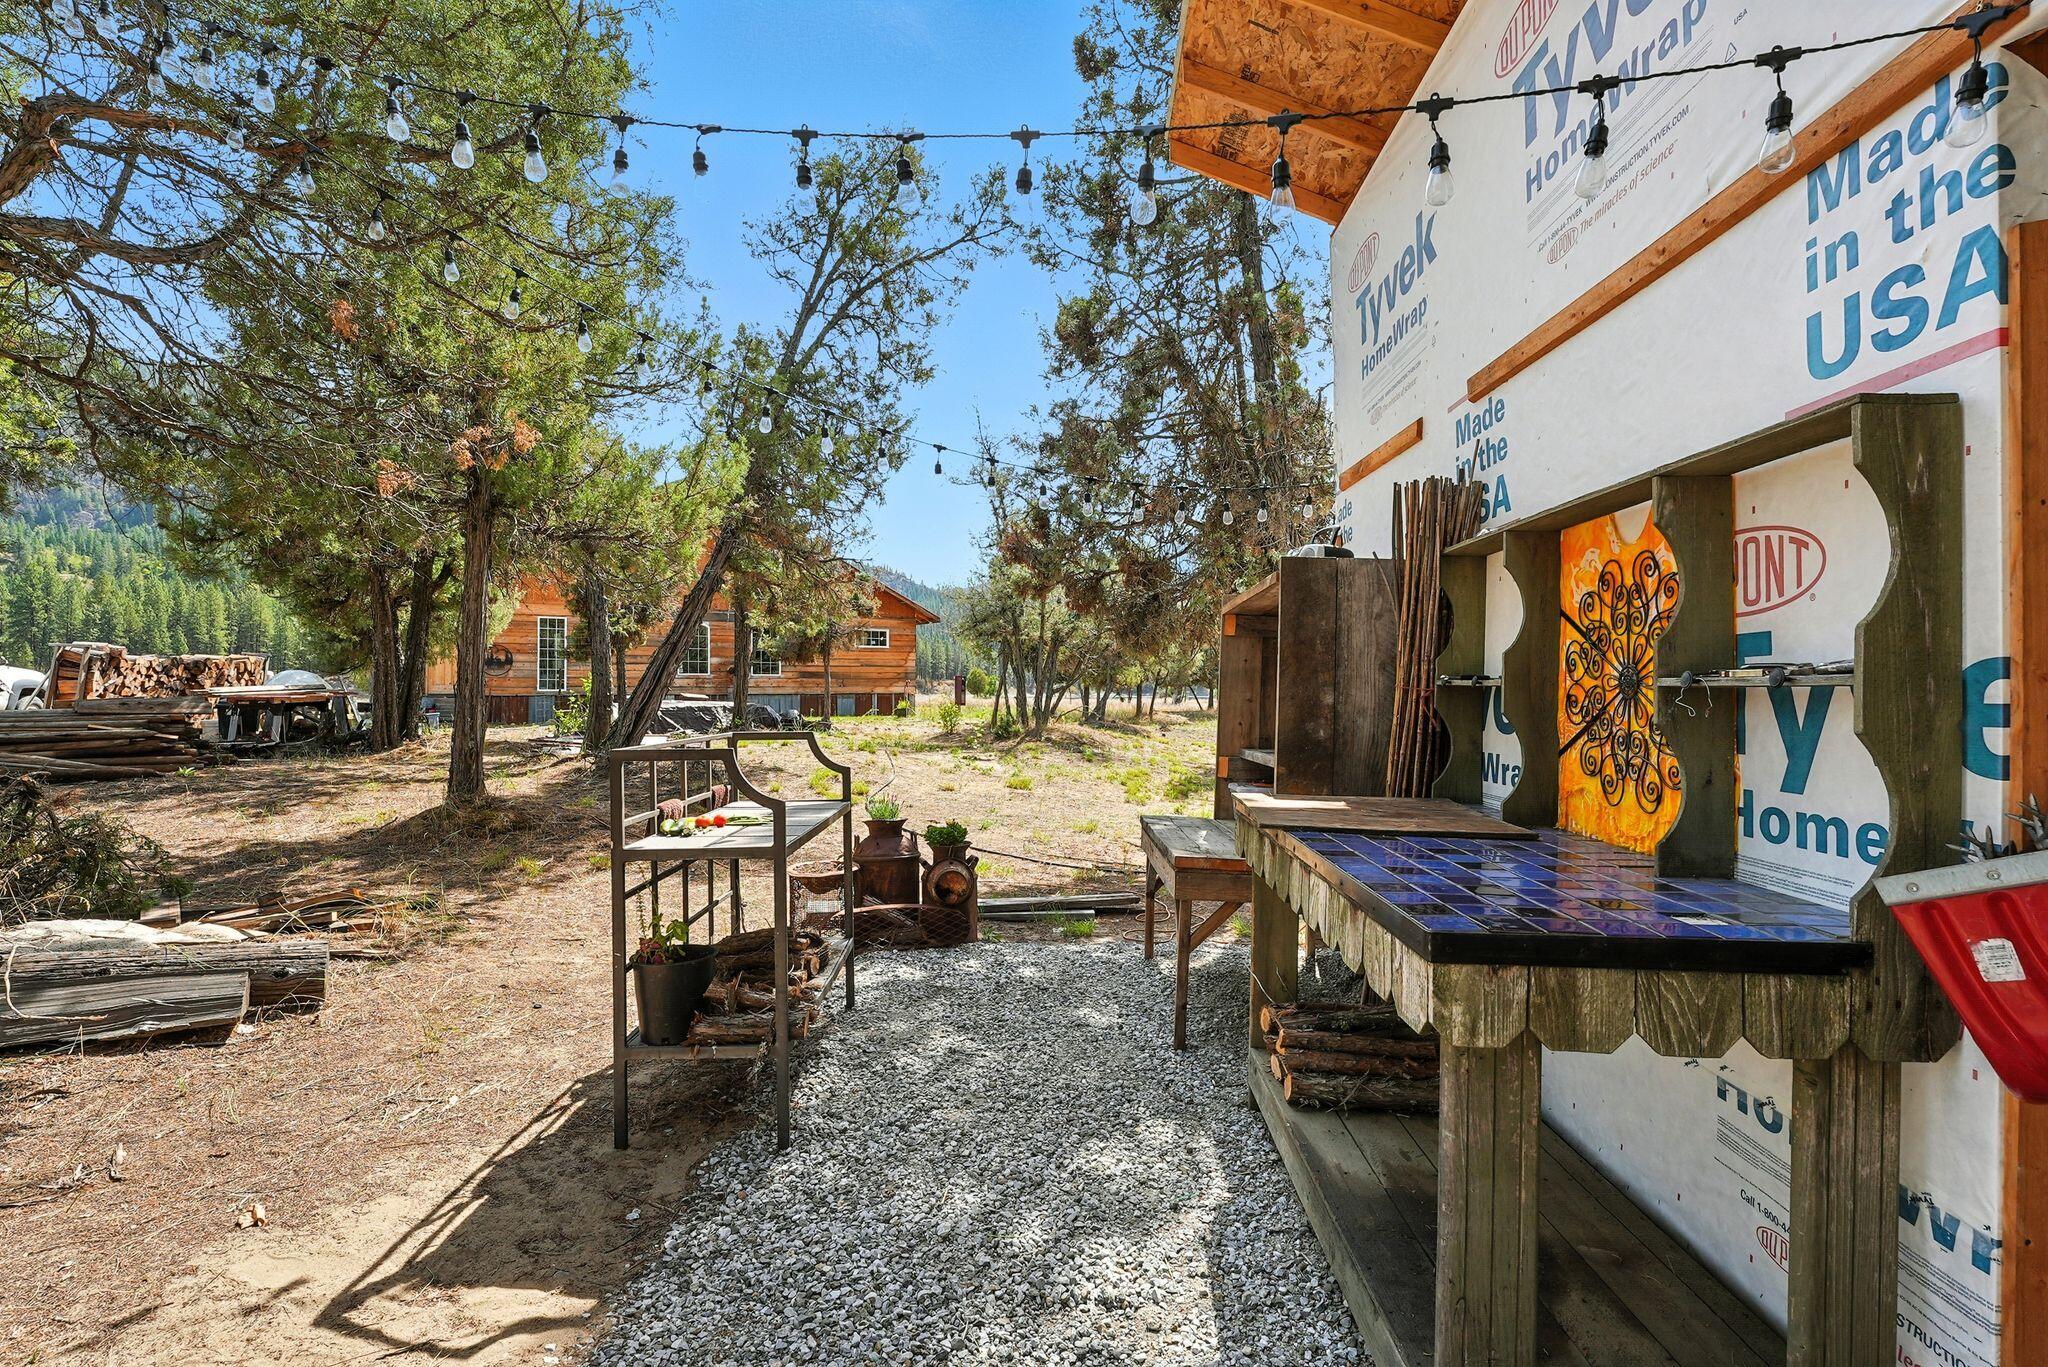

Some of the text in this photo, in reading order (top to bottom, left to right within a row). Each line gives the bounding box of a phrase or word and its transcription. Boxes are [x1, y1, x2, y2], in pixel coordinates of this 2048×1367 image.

[1512, 0, 1655, 149] Tyv
[1807, 62, 2009, 225] Made
[1580, 216, 1593, 234] The
[1594, 184, 1628, 221] miracles
[1629, 170, 1640, 190] of
[1806, 143, 2016, 293] in the
[1350, 235, 1377, 289] DUPONT
[1356, 210, 1437, 347] Tyvek
[1806, 224, 2009, 380] USA
[1361, 296, 1427, 381] HomeWrap
[1455, 396, 1506, 448] Made
[1478, 436, 1508, 472] the
[1338, 498, 1353, 523] ade
[1480, 474, 1512, 524] SA
[1735, 534, 1810, 607] ONT
[1740, 1188, 1756, 1207] Call
